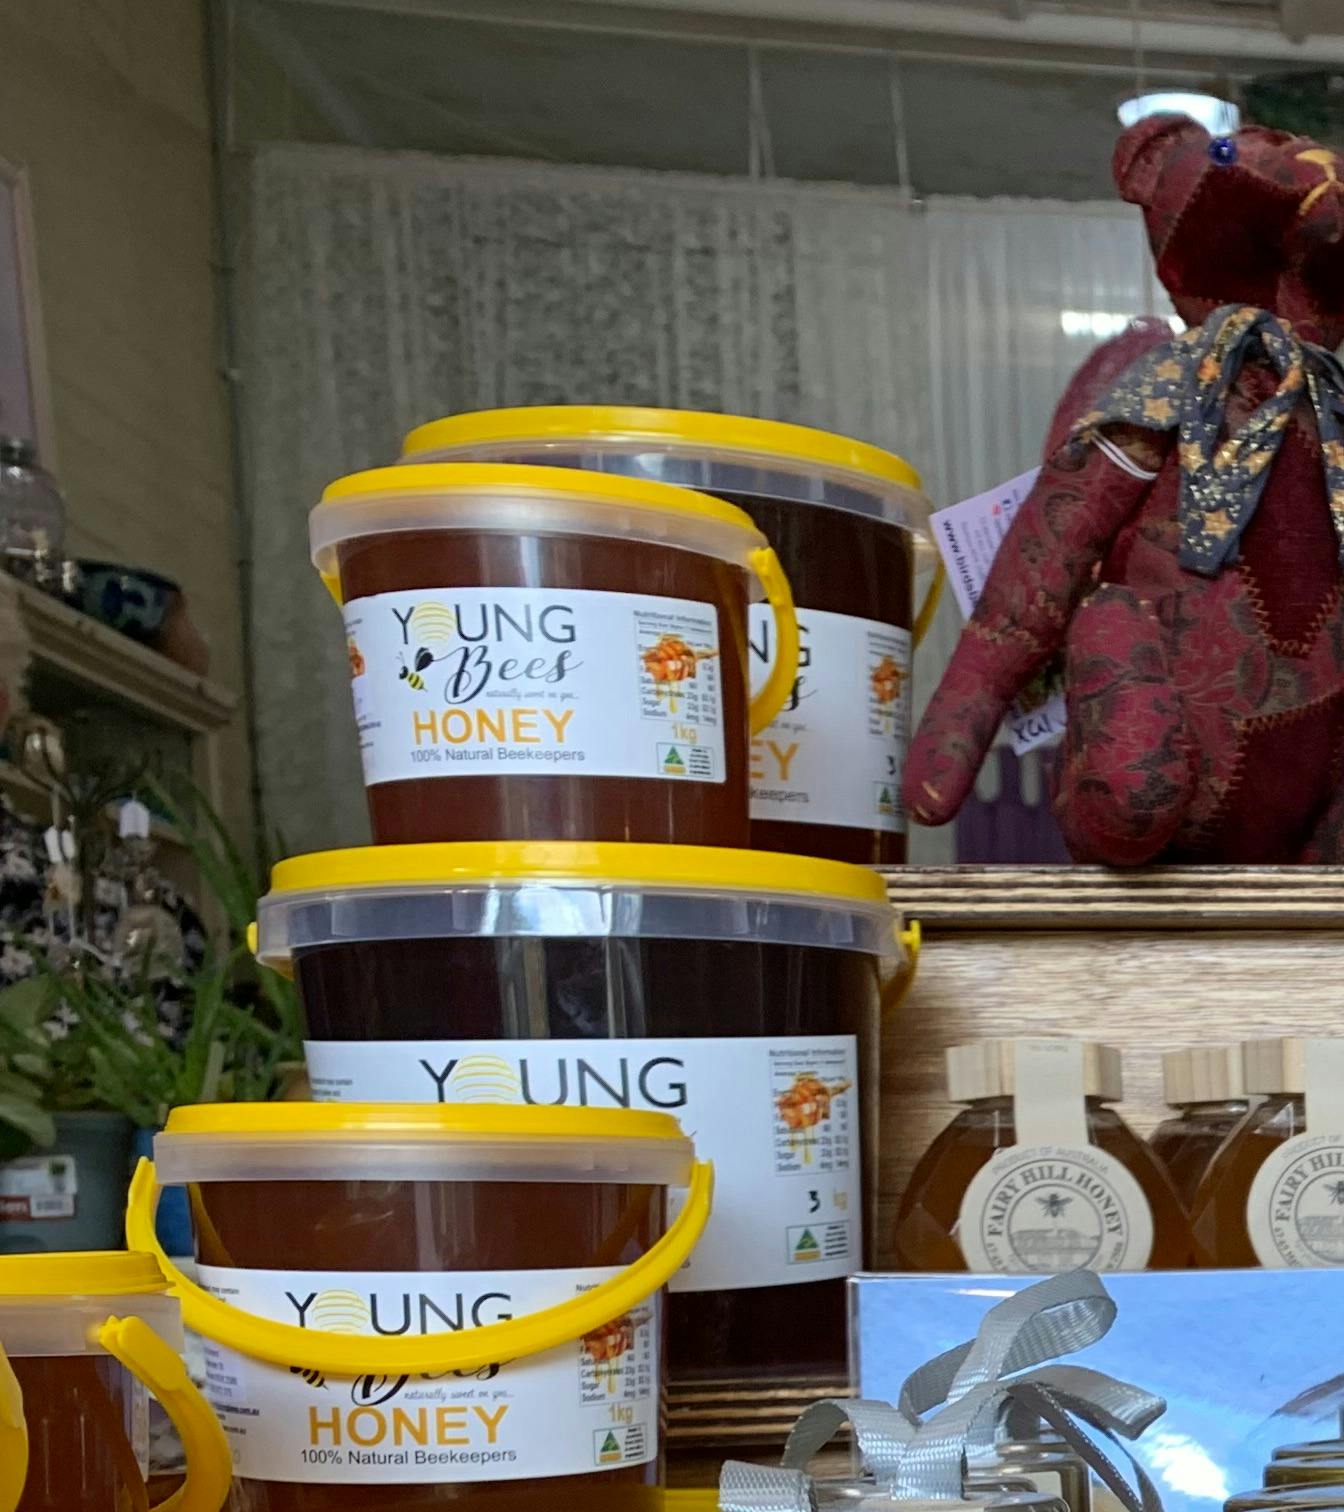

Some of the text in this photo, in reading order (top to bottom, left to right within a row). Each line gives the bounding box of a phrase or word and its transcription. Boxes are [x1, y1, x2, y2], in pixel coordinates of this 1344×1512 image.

[445, 645, 584, 704] Bees
[412, 709, 574, 745] HONEY
[672, 722, 698, 744] 1kg
[410, 747, 585, 764] 100% Natural Beekeepers
[988, 1165, 1123, 1236] FAIRY HILL HONEY
[1276, 1165, 1307, 1221] FAIRY
[404, 1387, 447, 1401] naturally
[309, 1405, 508, 1446] HONEY
[609, 1403, 633, 1424] 1kg
[301, 1447, 517, 1467] 100% Natural Beekeepers
